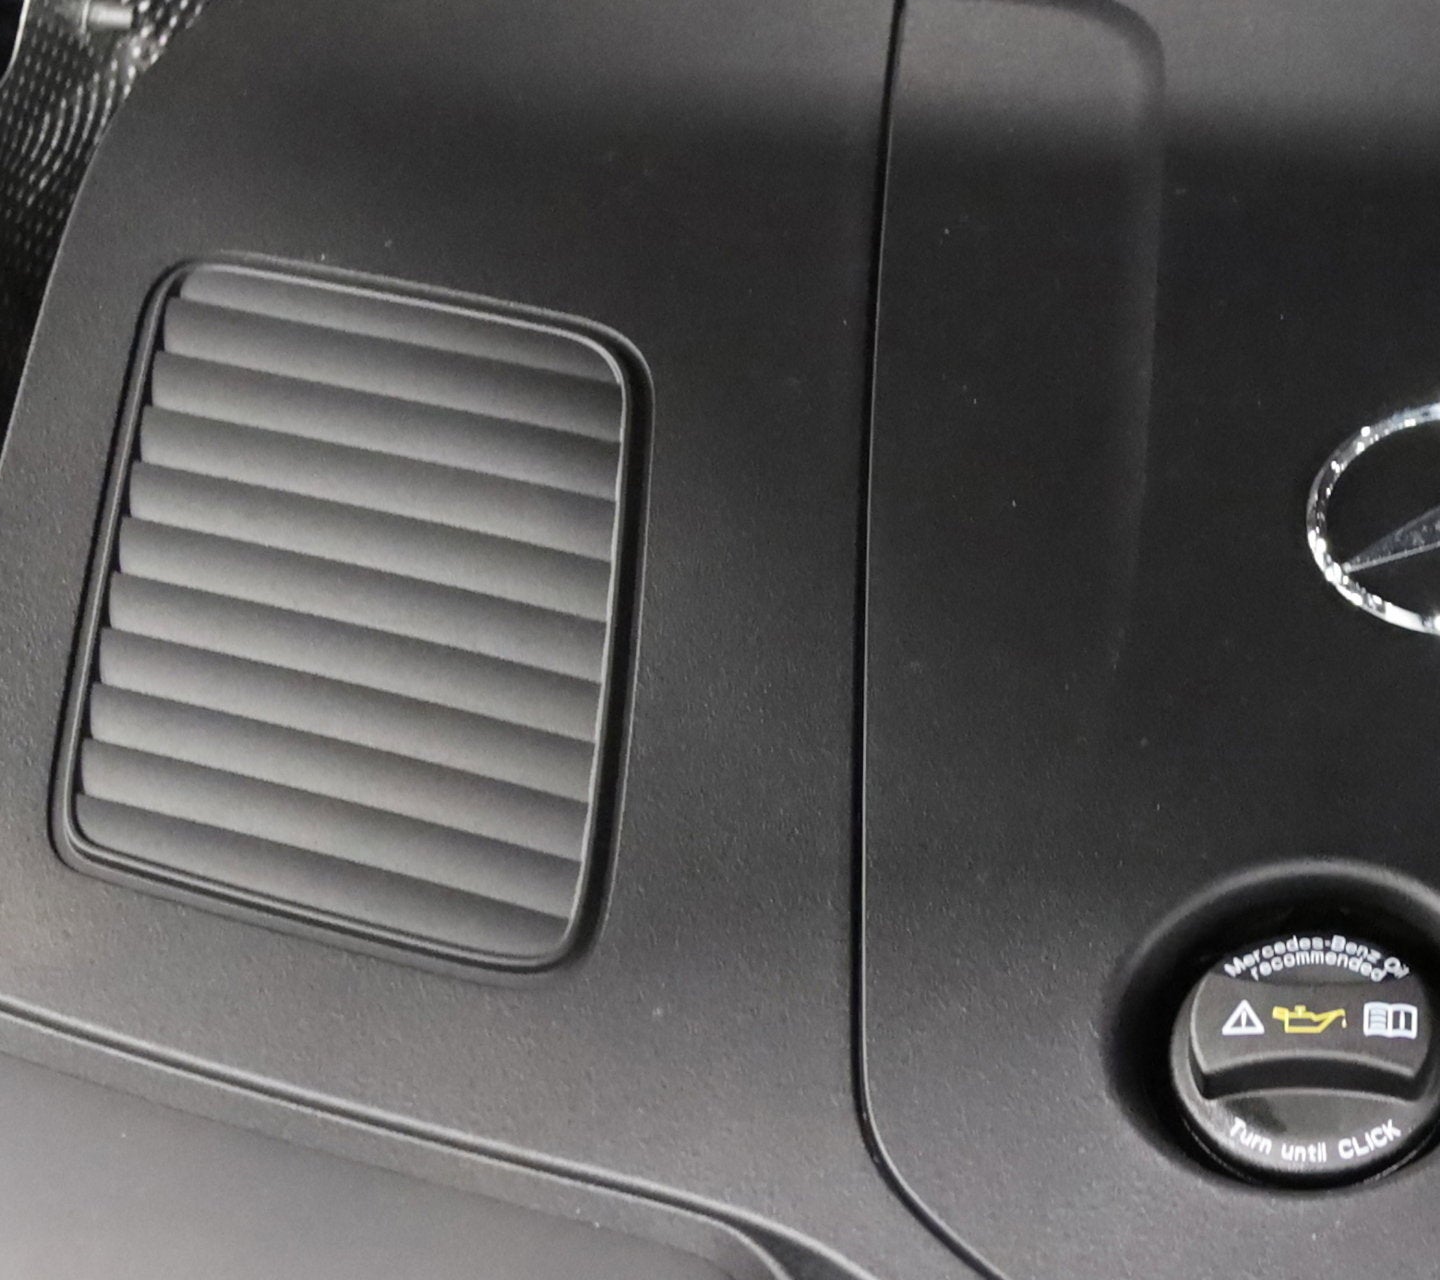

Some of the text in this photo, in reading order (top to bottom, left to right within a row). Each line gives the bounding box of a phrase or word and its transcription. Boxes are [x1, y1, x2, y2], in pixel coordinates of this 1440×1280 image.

[1224, 934, 1410, 980] Mercedes-Benz Oil
[1251, 950, 1387, 982] recommended
[1230, 1116, 1402, 1163] Turn until CLICK
